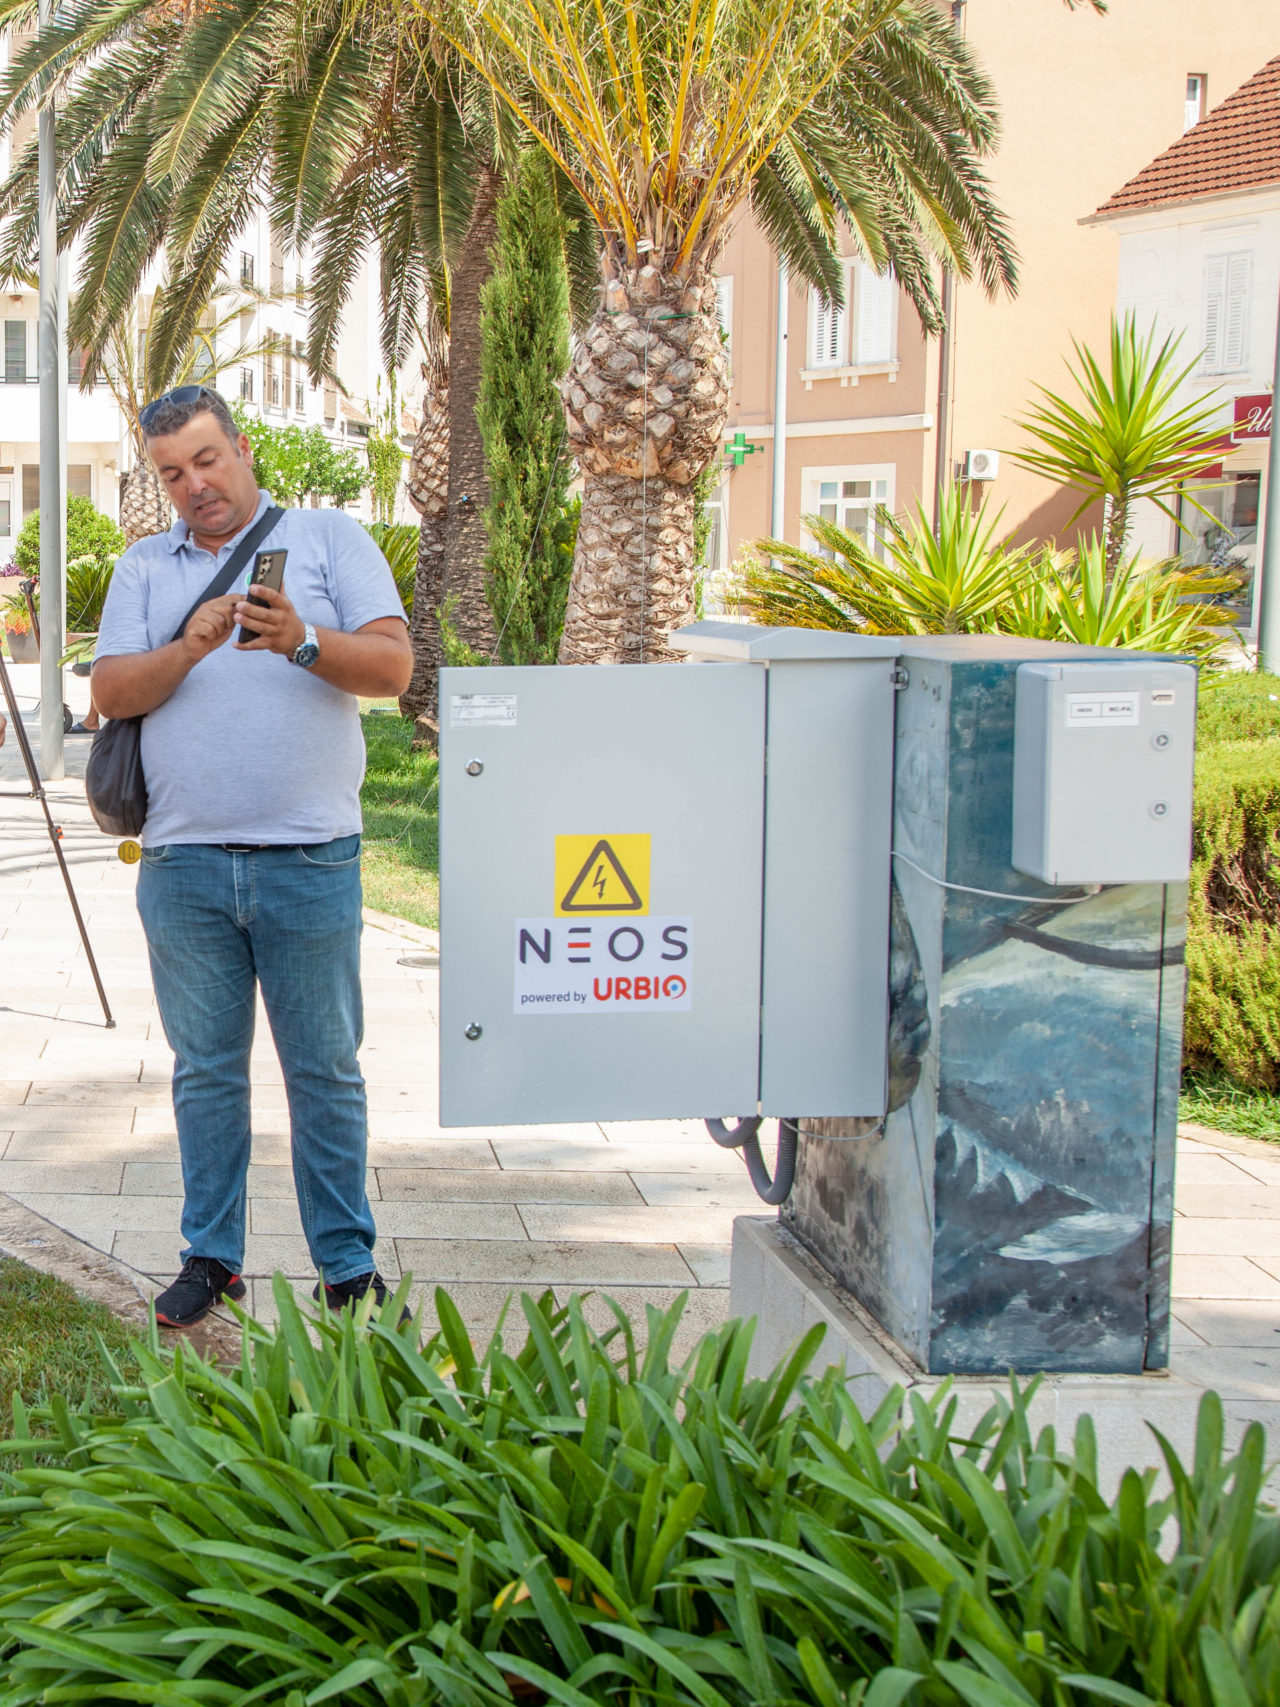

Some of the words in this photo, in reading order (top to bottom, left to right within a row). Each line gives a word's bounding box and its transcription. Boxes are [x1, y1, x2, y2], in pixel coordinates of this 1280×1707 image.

[519, 925, 688, 964] NEOS
[521, 992, 571, 1005] powered
[573, 991, 587, 1002] by
[593, 974, 687, 1001] URBIO
